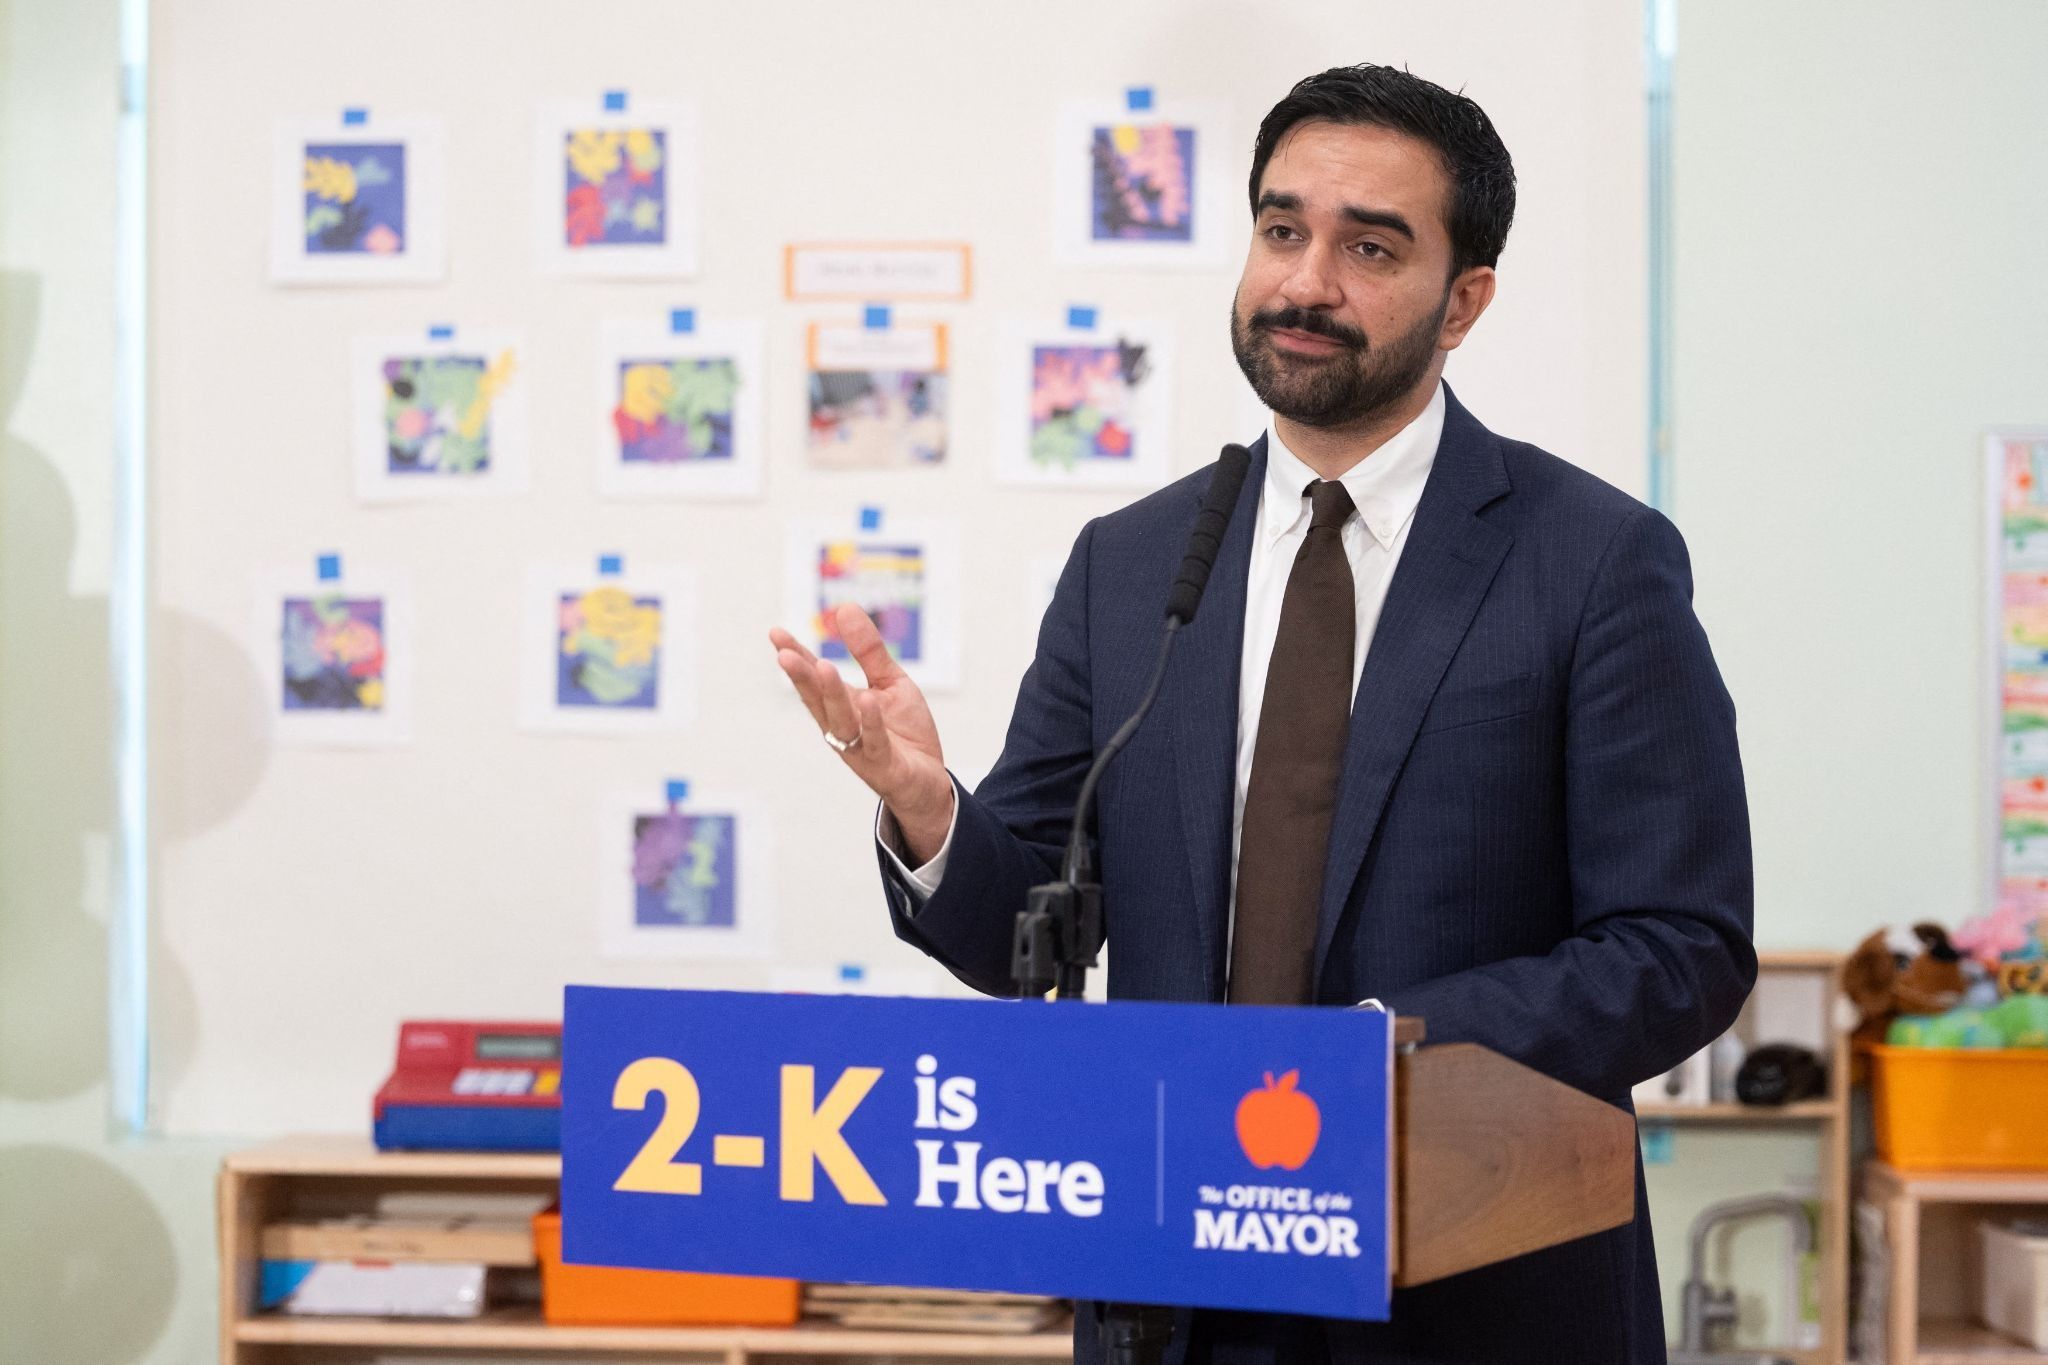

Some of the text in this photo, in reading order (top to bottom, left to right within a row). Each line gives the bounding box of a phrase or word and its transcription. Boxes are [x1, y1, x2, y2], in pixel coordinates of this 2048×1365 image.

[612, 1056, 888, 1206] 2-K
[914, 1054, 978, 1131] is
[914, 1139, 1105, 1218] Here
[1199, 1184, 1353, 1214] The OFFICE of the
[1194, 1209, 1361, 1258] MAYOR
